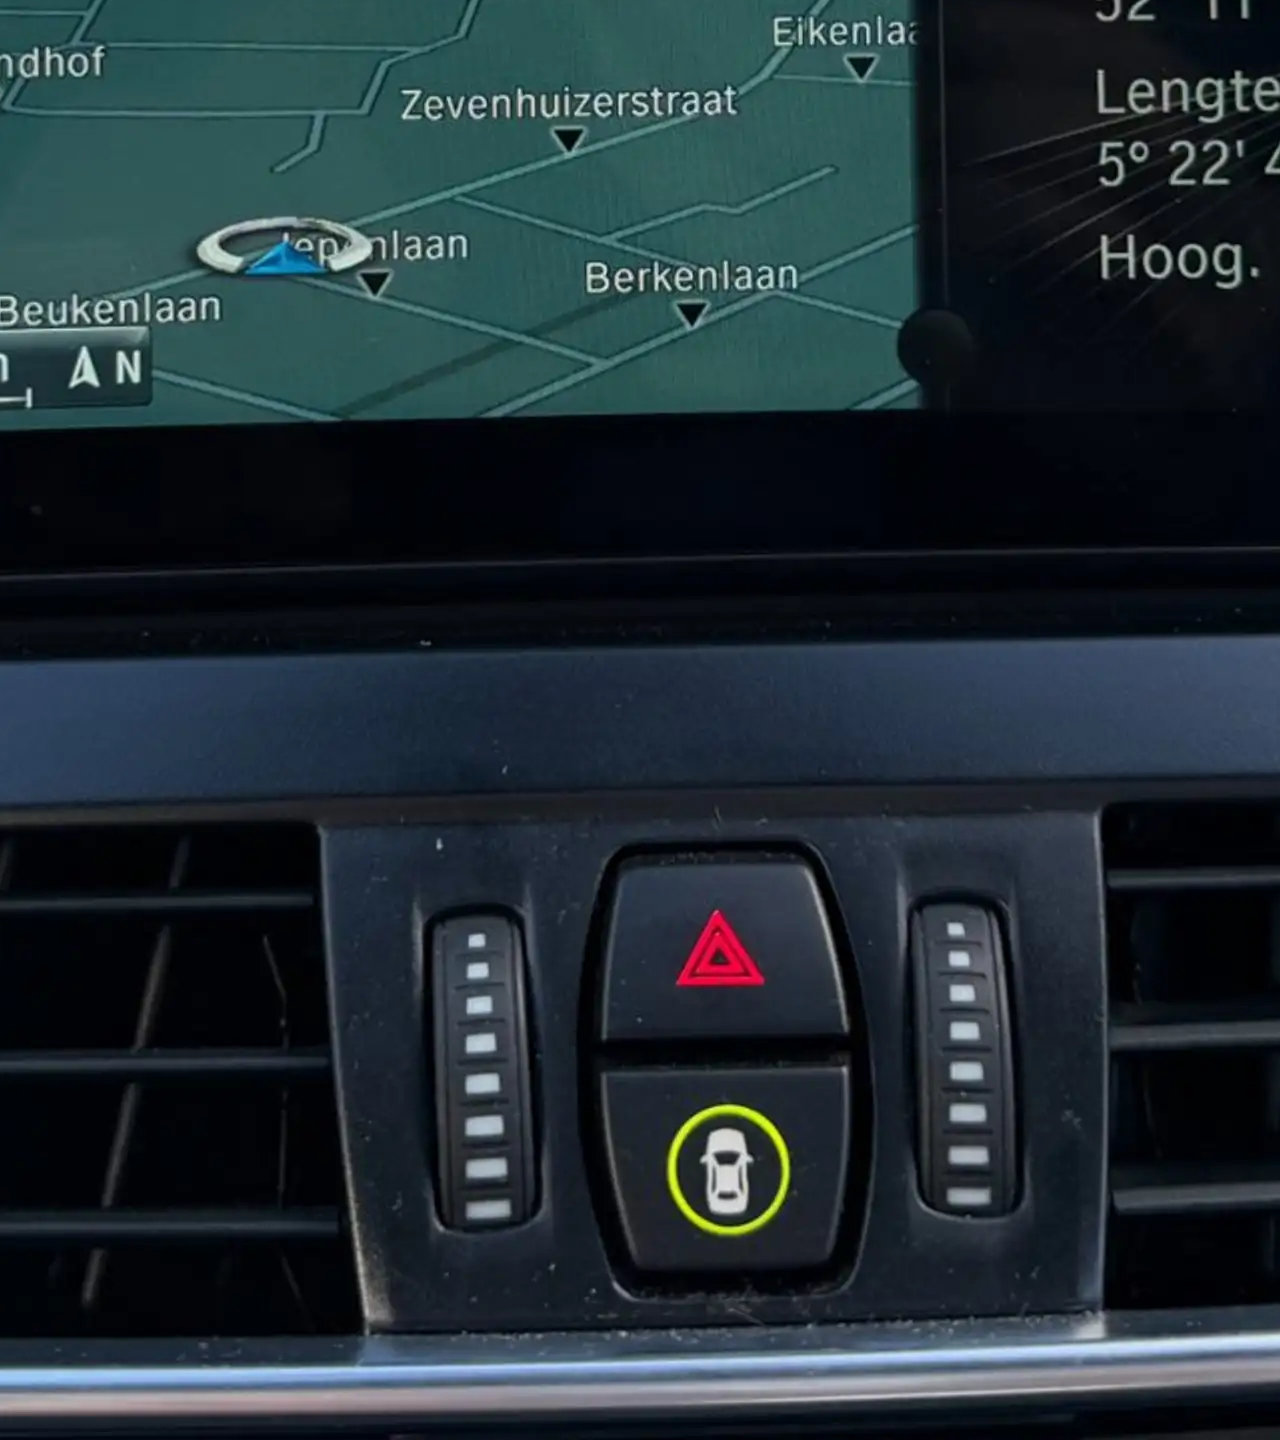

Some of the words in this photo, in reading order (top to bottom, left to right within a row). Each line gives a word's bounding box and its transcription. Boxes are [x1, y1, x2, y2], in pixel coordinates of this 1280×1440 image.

[401, 85, 739, 122] Zevenhuizerstraat
[1098, 140, 1151, 188] 5°
[1167, 139, 1248, 187] 22'
[282, 229, 468, 266] epnlaan
[1099, 231, 1261, 289] Hoog.
[585, 261, 799, 295] Berkenlaan
[115, 350, 143, 385] N
